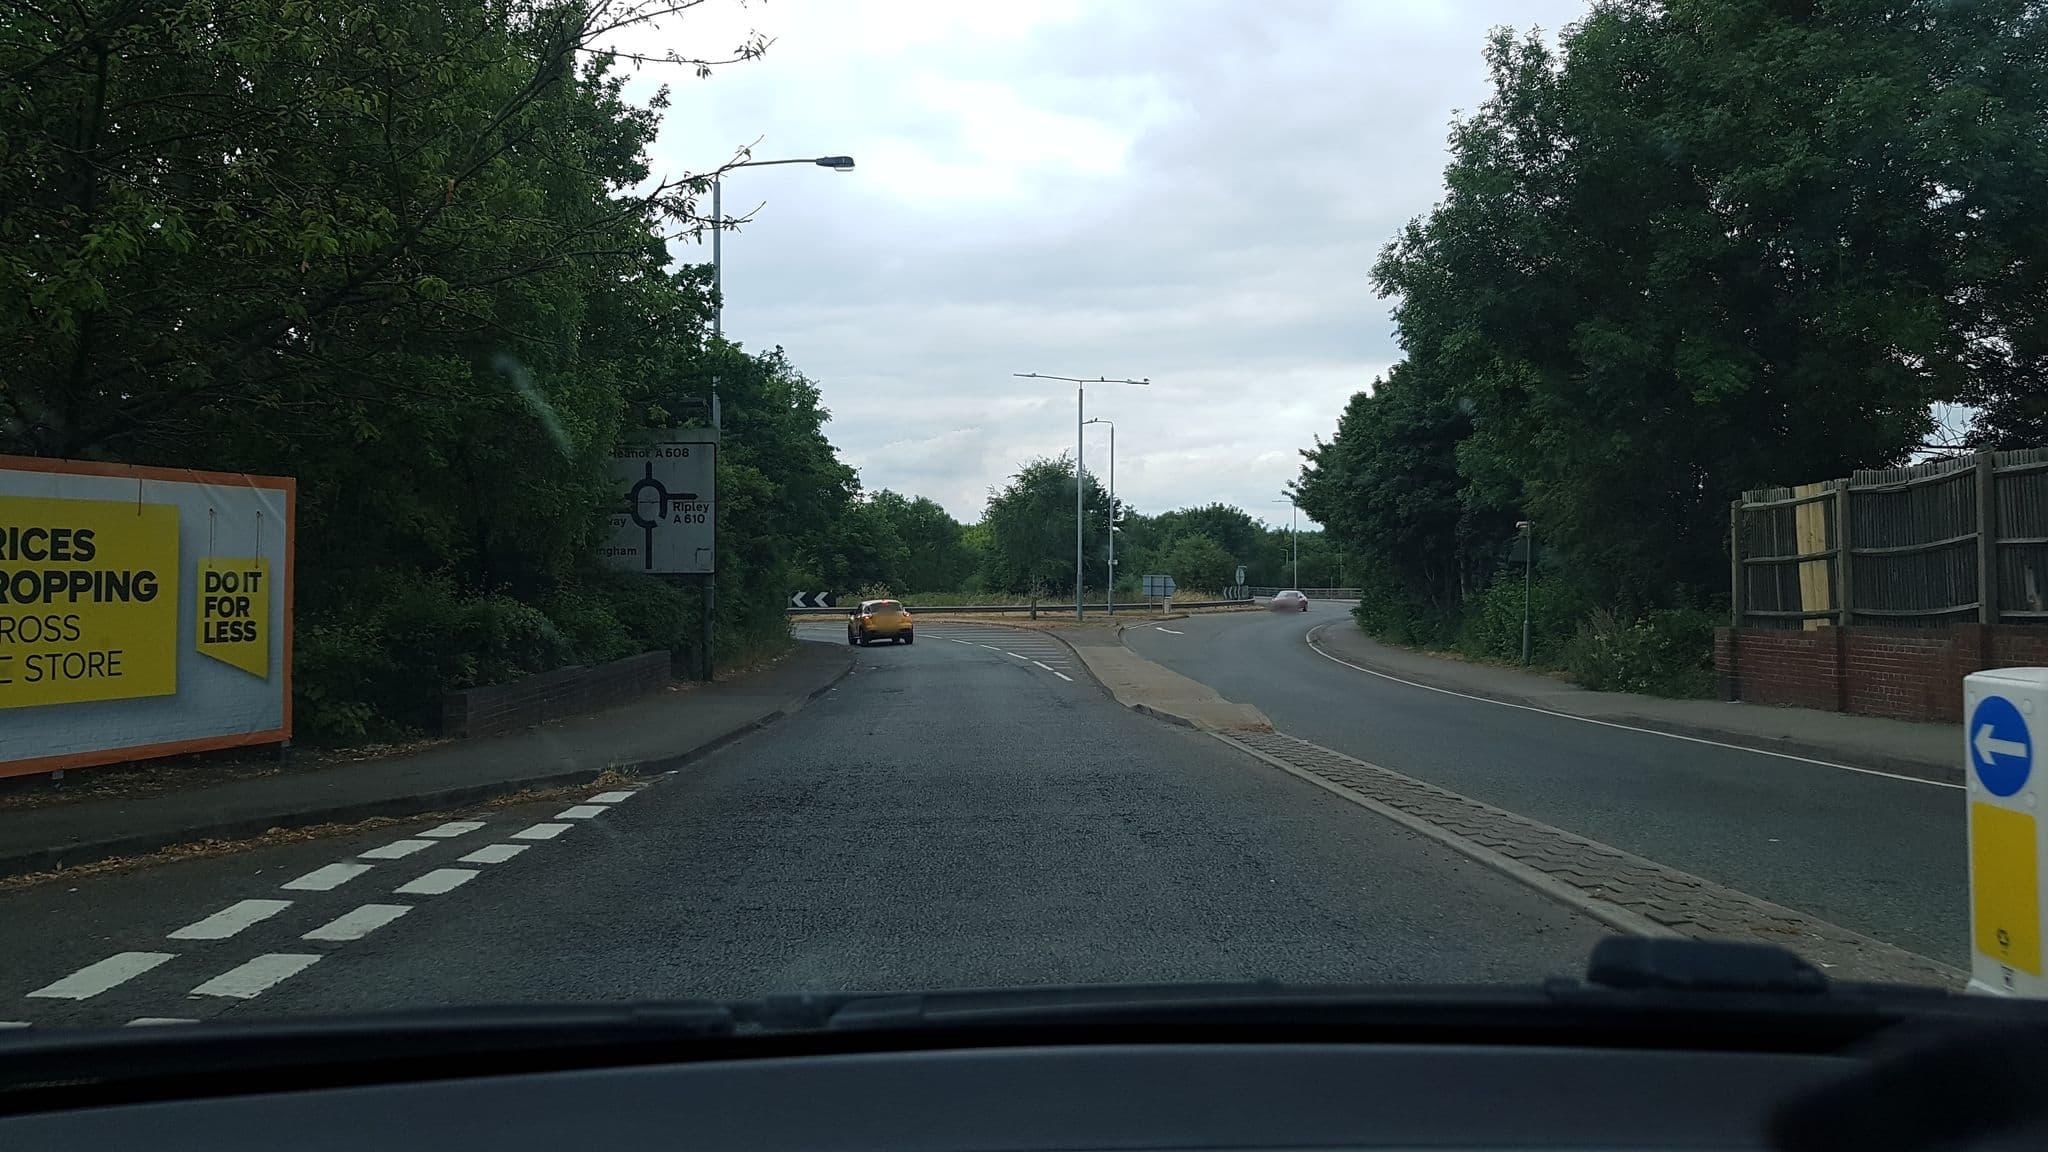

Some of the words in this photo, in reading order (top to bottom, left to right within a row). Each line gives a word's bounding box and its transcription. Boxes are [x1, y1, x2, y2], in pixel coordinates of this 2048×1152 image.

[672, 502, 710, 513] Ripley
[204, 571, 239, 594] DO
[242, 571, 262, 593] IT
[204, 597, 250, 618] FOR
[203, 621, 257, 644] LESS
[24, 650, 123, 683] STORE
